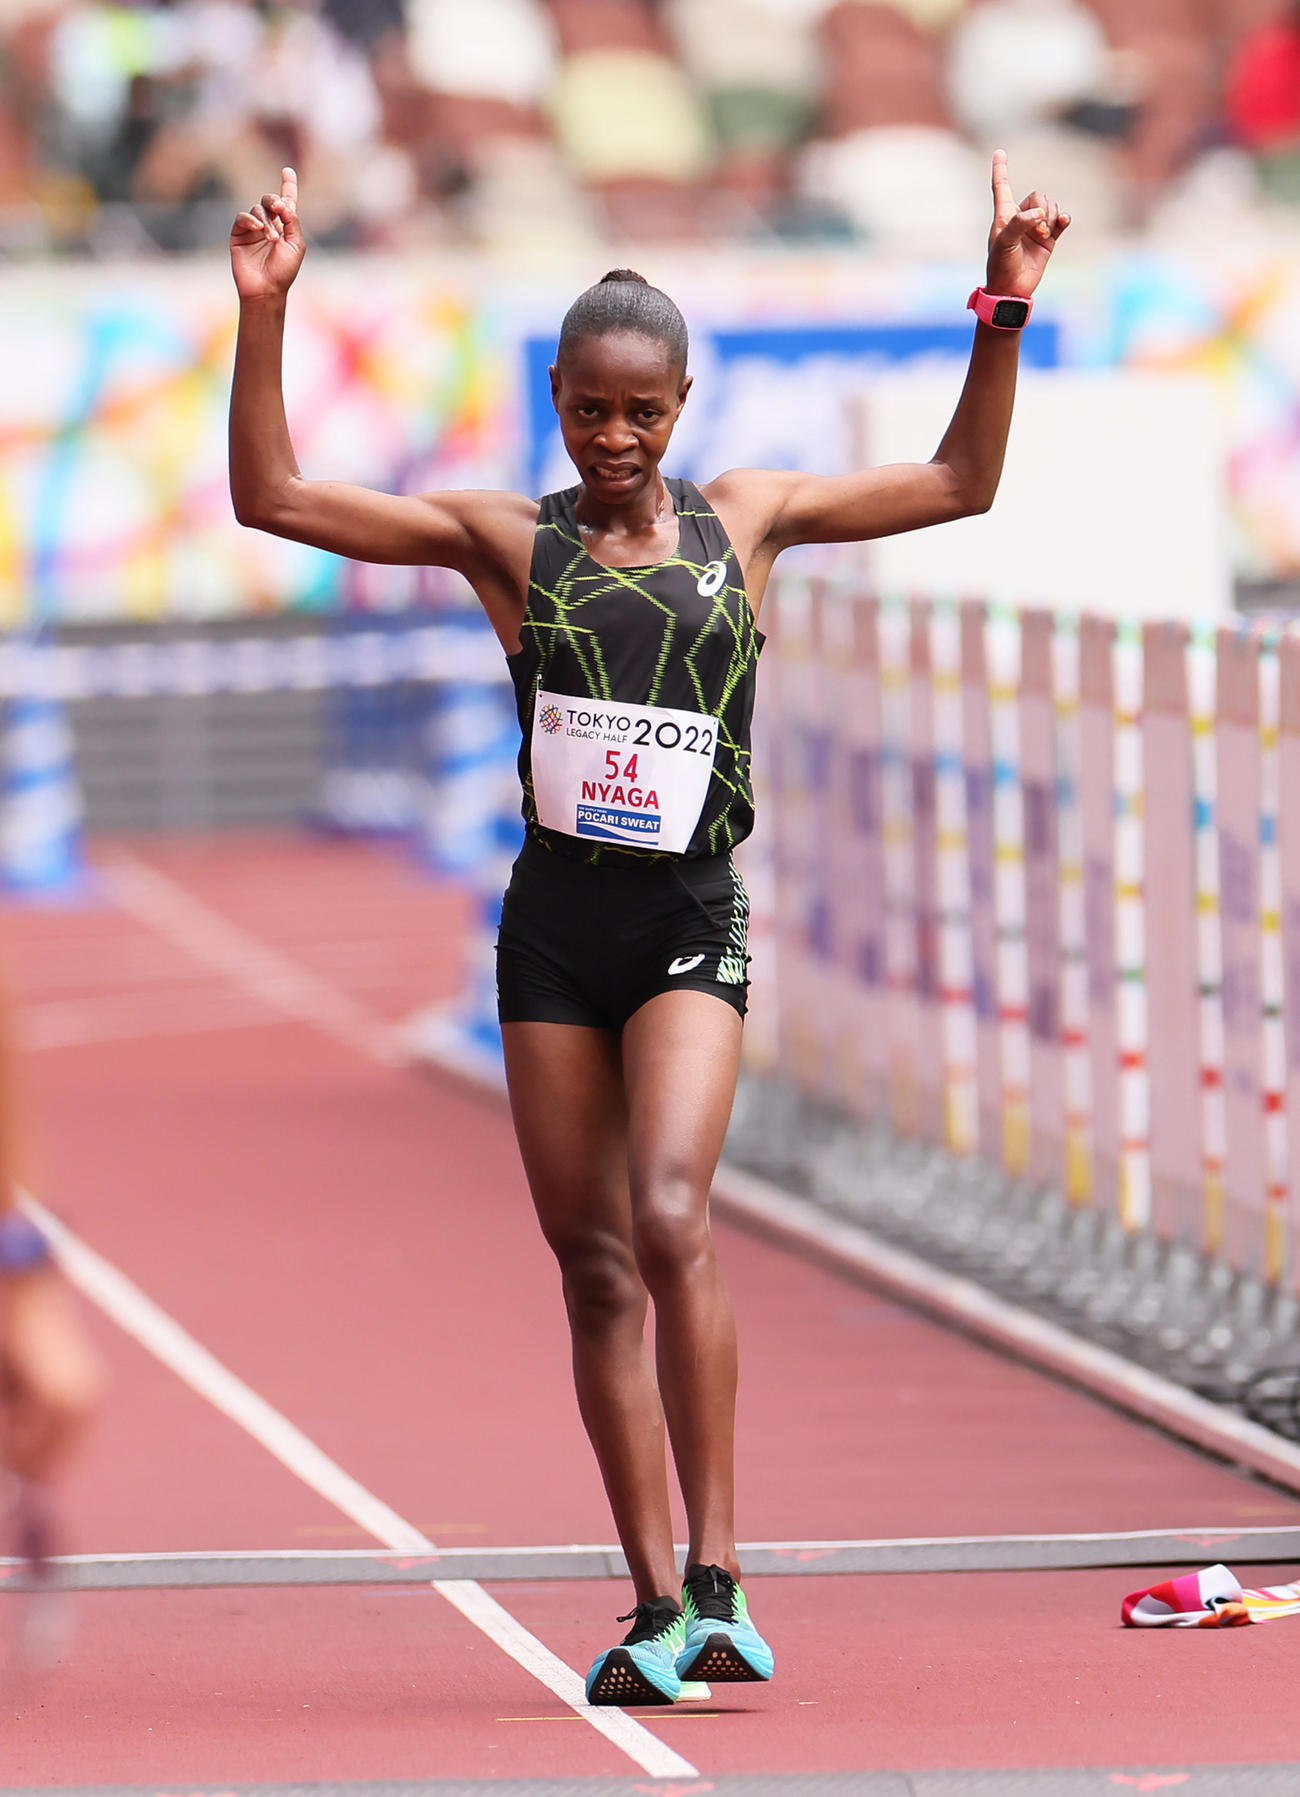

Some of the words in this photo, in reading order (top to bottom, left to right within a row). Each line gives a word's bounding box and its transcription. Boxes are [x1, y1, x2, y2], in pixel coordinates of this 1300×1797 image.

[566, 709, 631, 732] TOKYO
[632, 719, 713, 756] 2022
[566, 727, 601, 741] LEGACY
[603, 733, 628, 744] HALF
[605, 750, 638, 783] 54
[581, 780, 660, 810] NYAGA
[578, 810, 619, 825] POCARI
[620, 816, 660, 831] SWEAT
